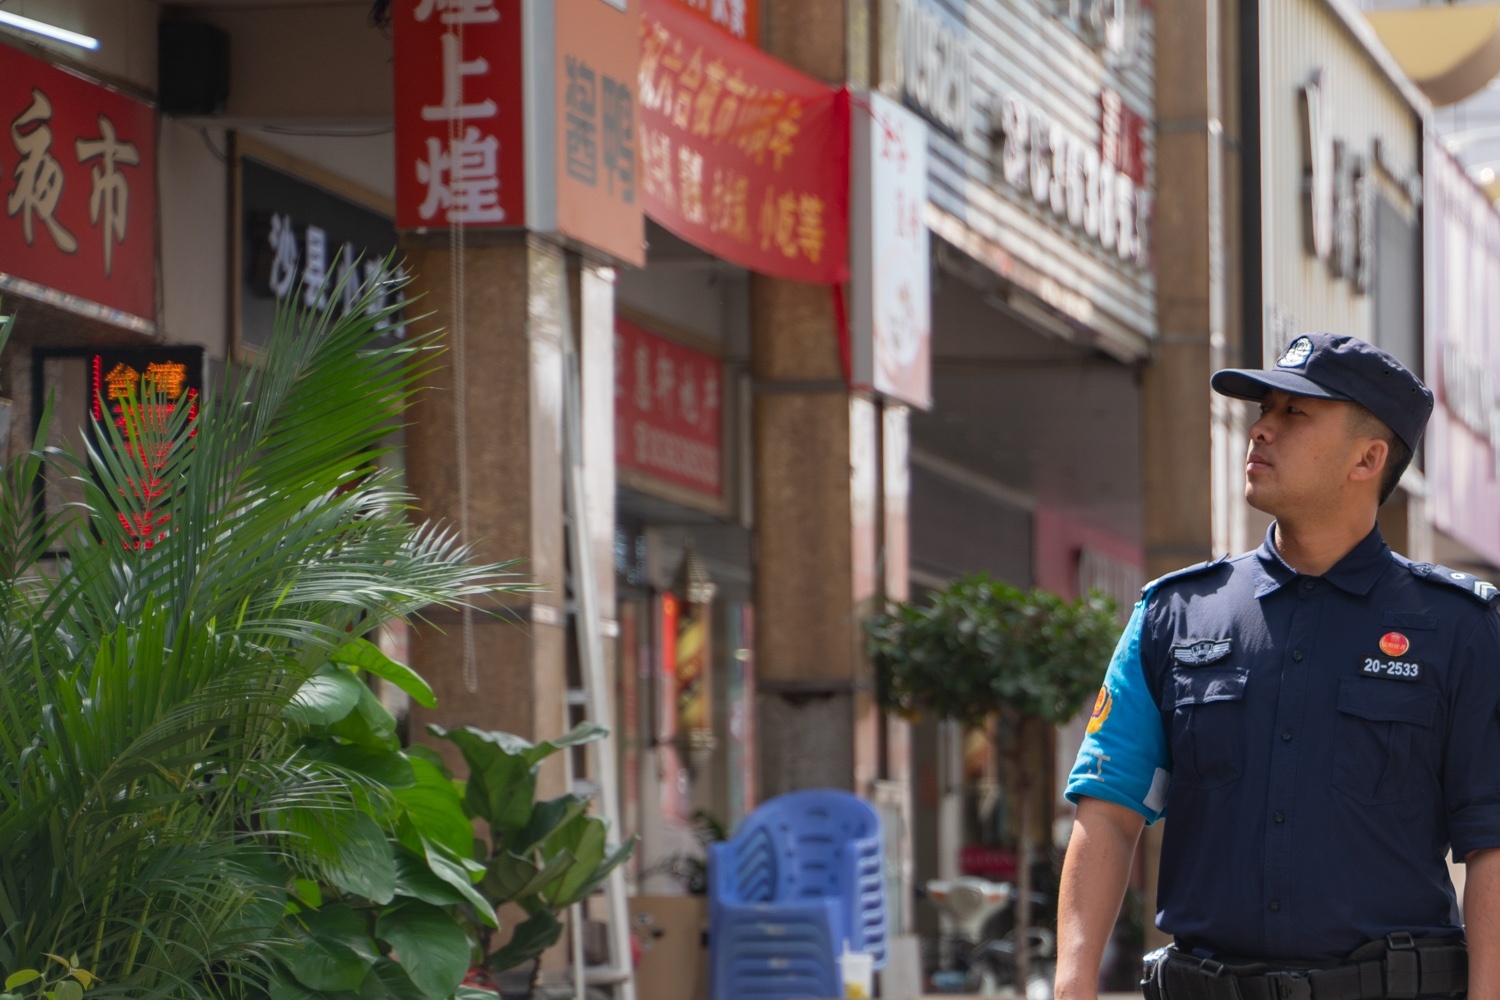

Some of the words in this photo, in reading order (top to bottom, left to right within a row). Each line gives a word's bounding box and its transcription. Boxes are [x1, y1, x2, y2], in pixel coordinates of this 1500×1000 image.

[7, 87, 140, 279] 夜市
[415, 0, 505, 224] 上煌
[1363, 658, 1419, 677] 20-2533
